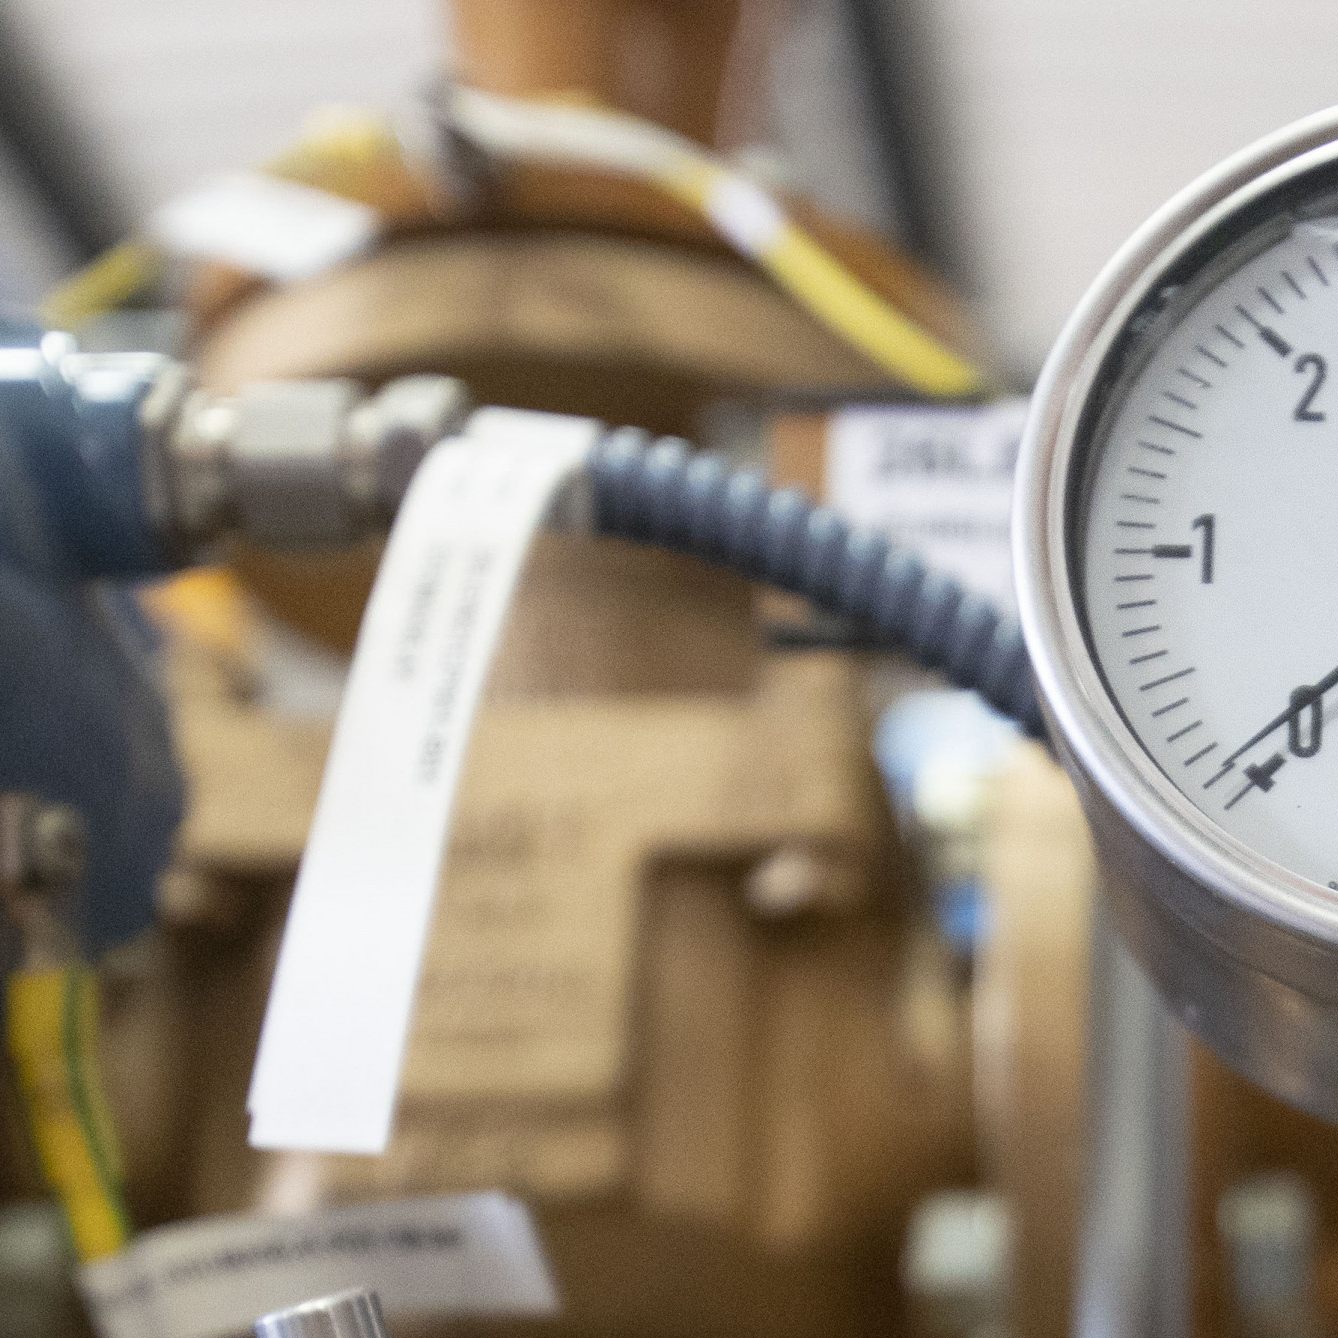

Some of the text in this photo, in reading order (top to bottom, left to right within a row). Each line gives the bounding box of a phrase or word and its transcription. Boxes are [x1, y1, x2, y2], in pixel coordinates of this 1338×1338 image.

[1294, 353, 1329, 424] 2
[1191, 513, 1216, 585] 1
[1287, 684, 1323, 759] 0
